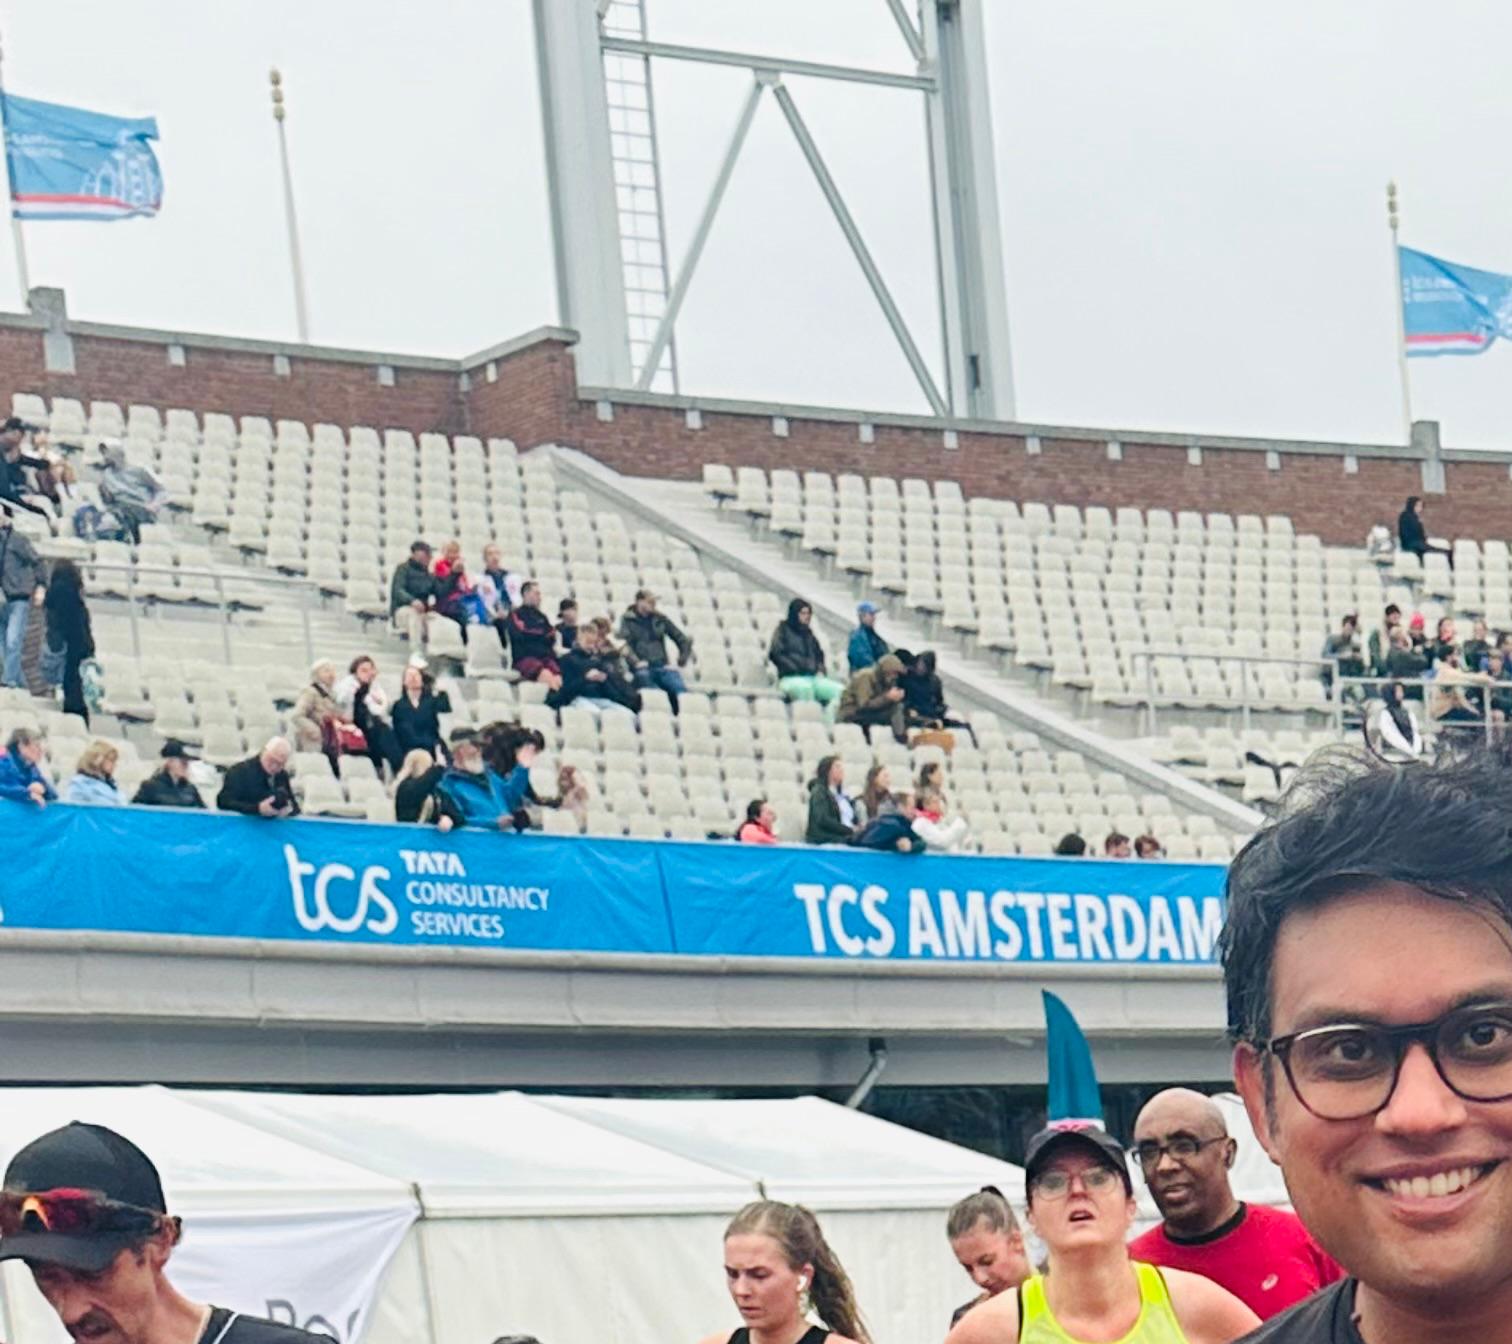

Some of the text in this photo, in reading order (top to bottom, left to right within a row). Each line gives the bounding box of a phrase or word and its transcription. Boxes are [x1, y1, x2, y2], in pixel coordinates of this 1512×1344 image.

[399, 850, 466, 877] TATA
[284, 843, 399, 936] tcs
[405, 881, 549, 911] CONSULTANCY
[411, 911, 504, 939] SERVICES
[793, 884, 1224, 962] TCS AMSTERDAM
